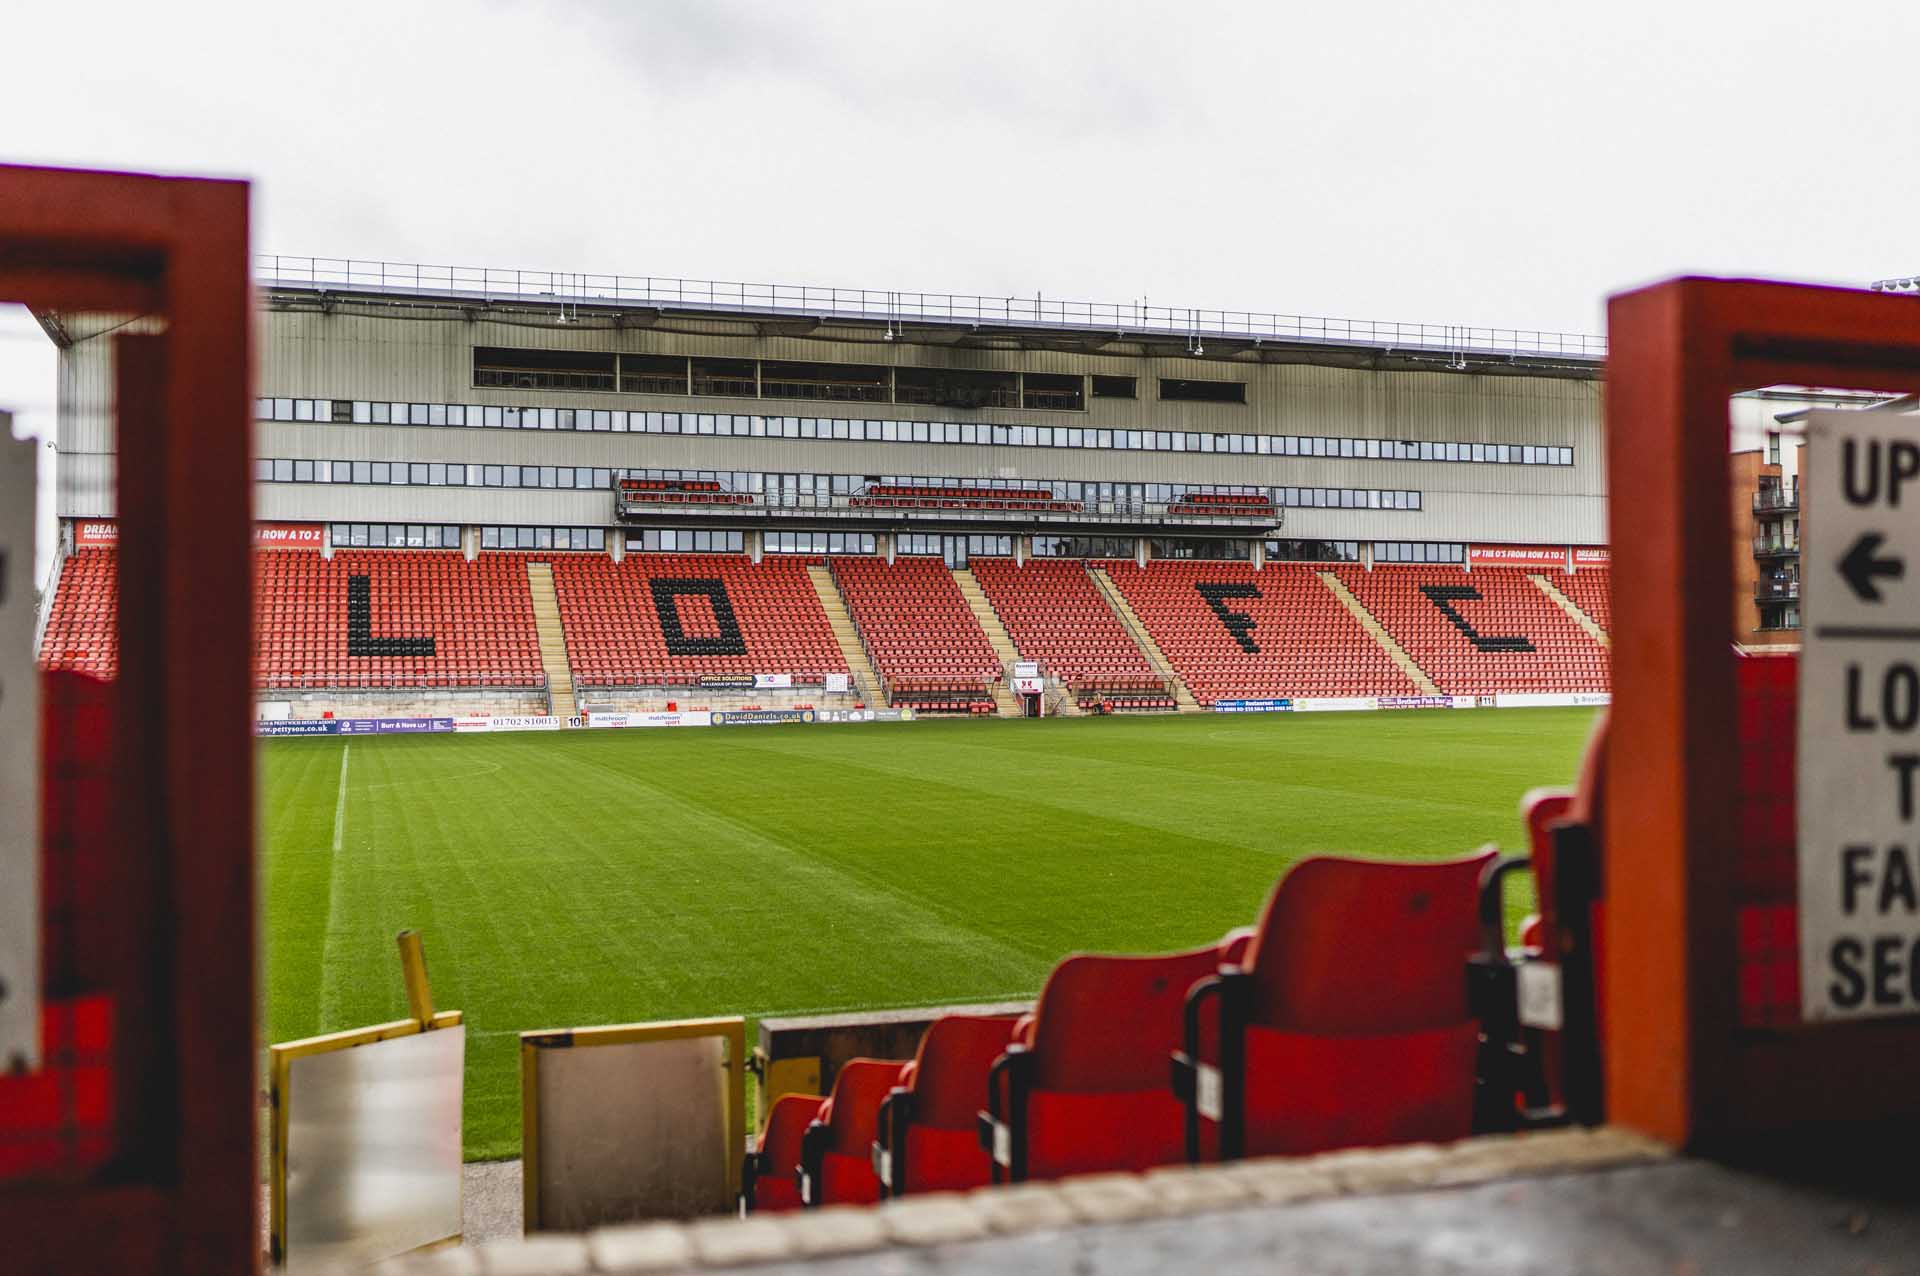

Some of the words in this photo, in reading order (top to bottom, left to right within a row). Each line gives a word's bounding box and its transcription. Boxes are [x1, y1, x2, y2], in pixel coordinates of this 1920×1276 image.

[1842, 436, 1920, 508] UP
[262, 529, 288, 540] ROW
[288, 530, 297, 540] A
[299, 530, 312, 540] TO
[313, 530, 321, 540] Z
[1471, 549, 1481, 558] UP
[1482, 550, 1495, 558] THE
[1507, 550, 1527, 559] FROM
[1527, 551, 1544, 559] ROW
[1550, 551, 1560, 560] TO
[1576, 549, 1600, 558] DREAM
[1845, 662, 1920, 733] LO
[725, 712, 801, 720] DavidDaniels.co.uk
[493, 718, 521, 726] 01702
[568, 717, 581, 727] 10
[257, 725, 328, 735] ww.pettyson.co.uk
[1842, 846, 1920, 914] FA
